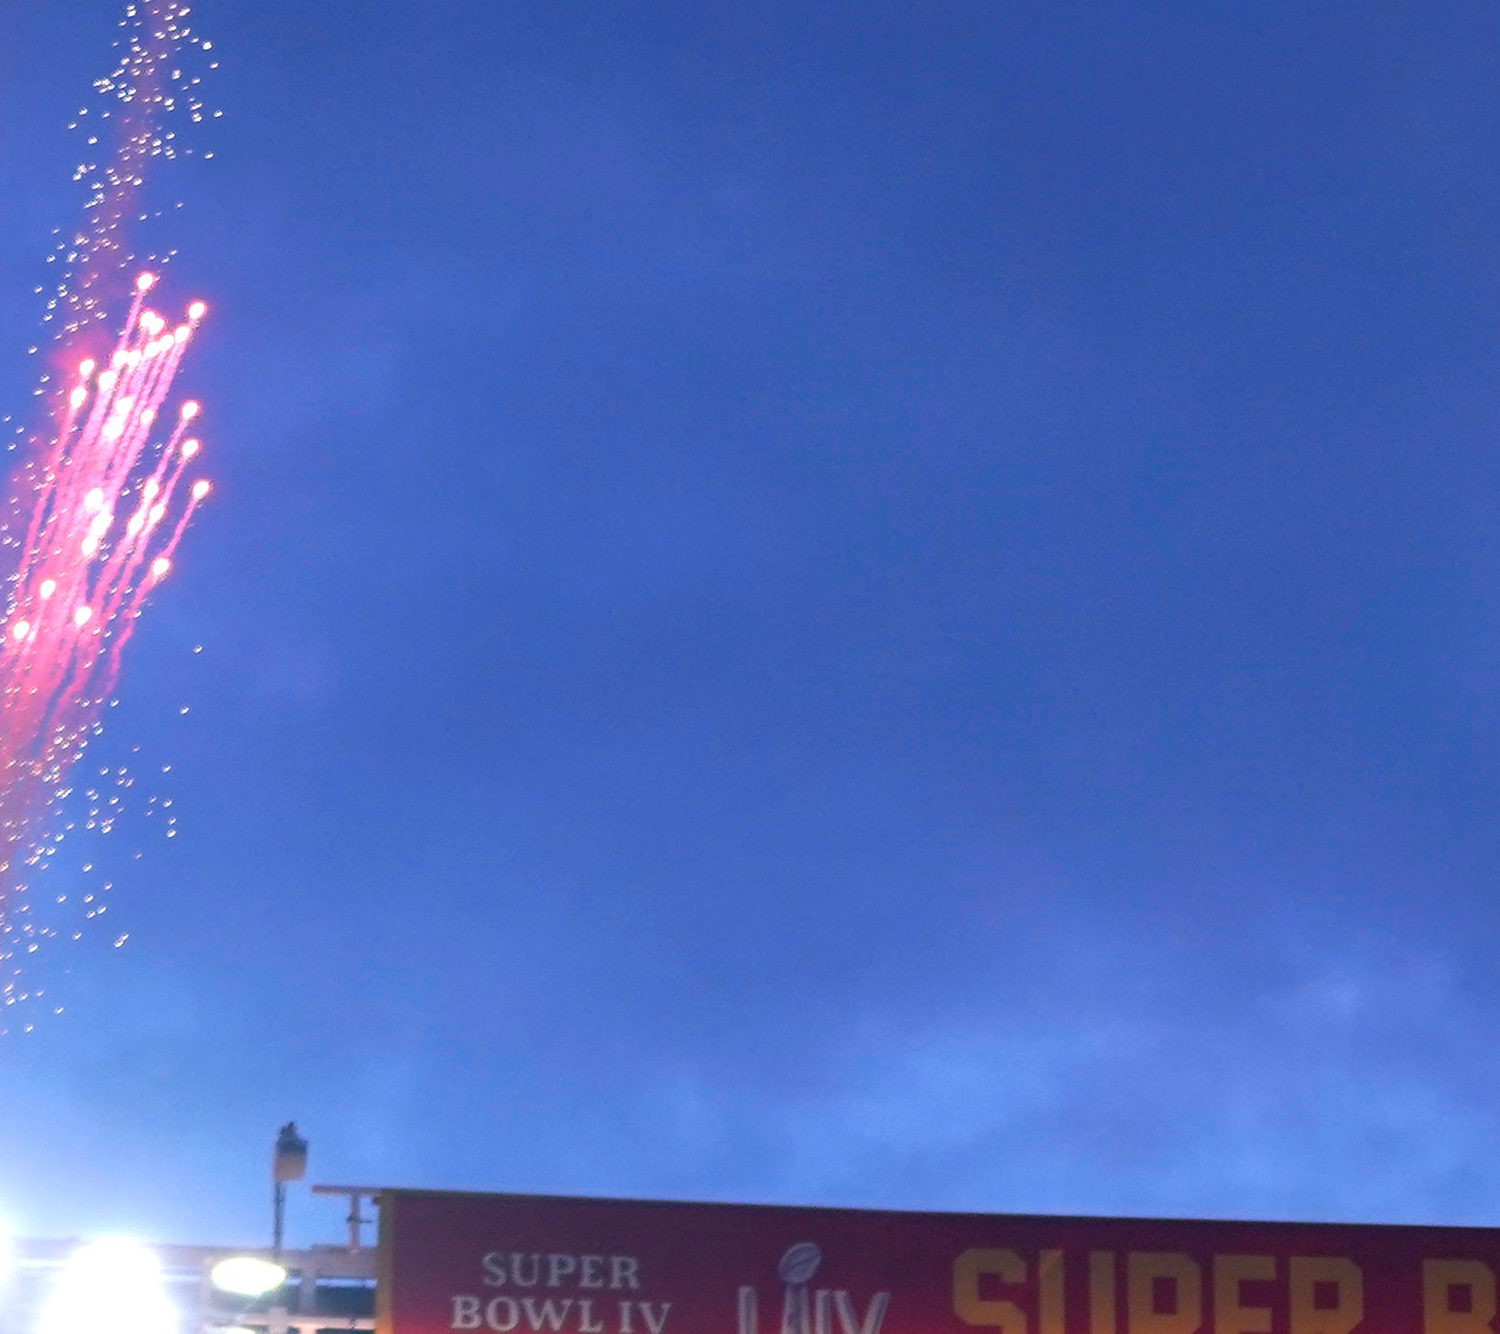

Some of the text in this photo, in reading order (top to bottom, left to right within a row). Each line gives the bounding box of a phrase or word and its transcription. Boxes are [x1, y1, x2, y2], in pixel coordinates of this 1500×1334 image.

[482, 1252, 640, 1289] SUPER
[451, 1294, 673, 1334] BOWL IV
